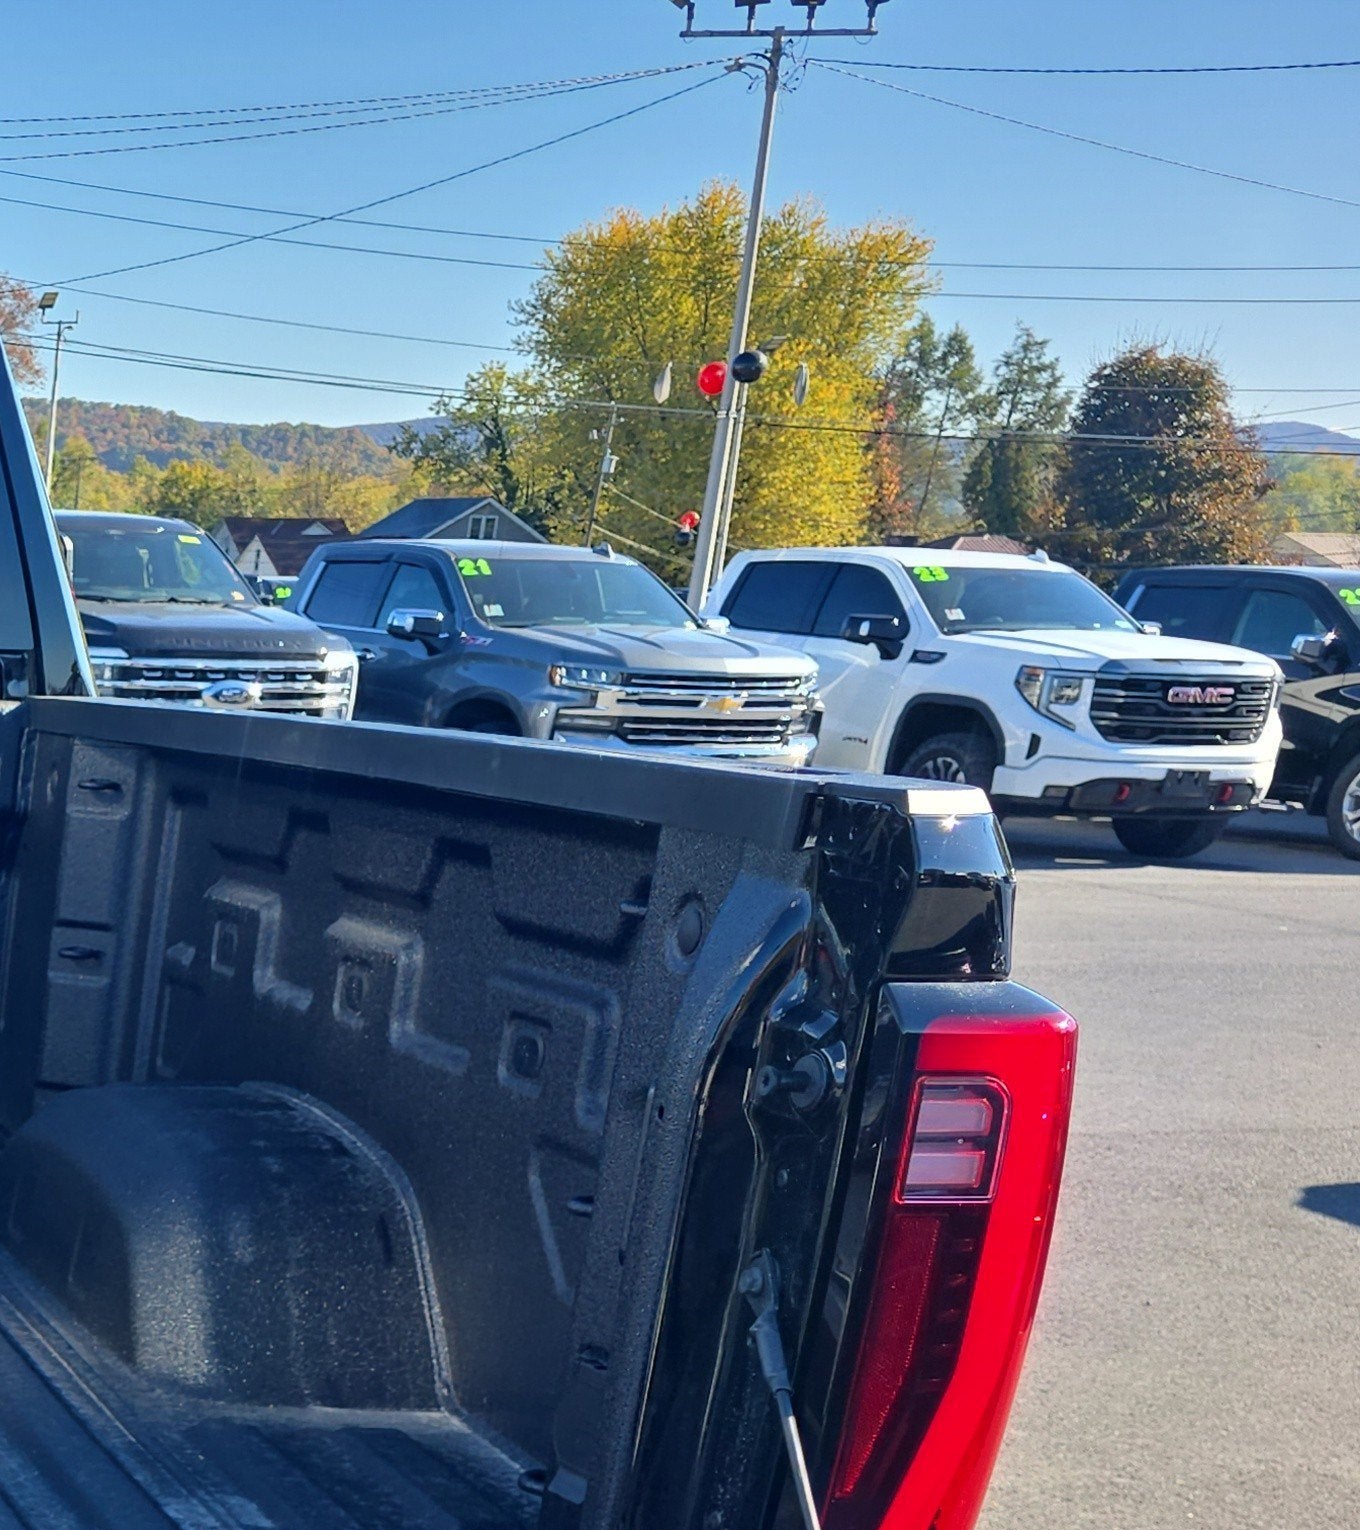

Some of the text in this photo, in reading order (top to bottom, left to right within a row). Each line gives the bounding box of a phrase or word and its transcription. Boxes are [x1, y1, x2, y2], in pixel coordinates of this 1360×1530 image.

[458, 558, 492, 576] 21
[913, 566, 949, 582] 23
[1339, 588, 1360, 604] 2
[1168, 686, 1235, 704] GMC
